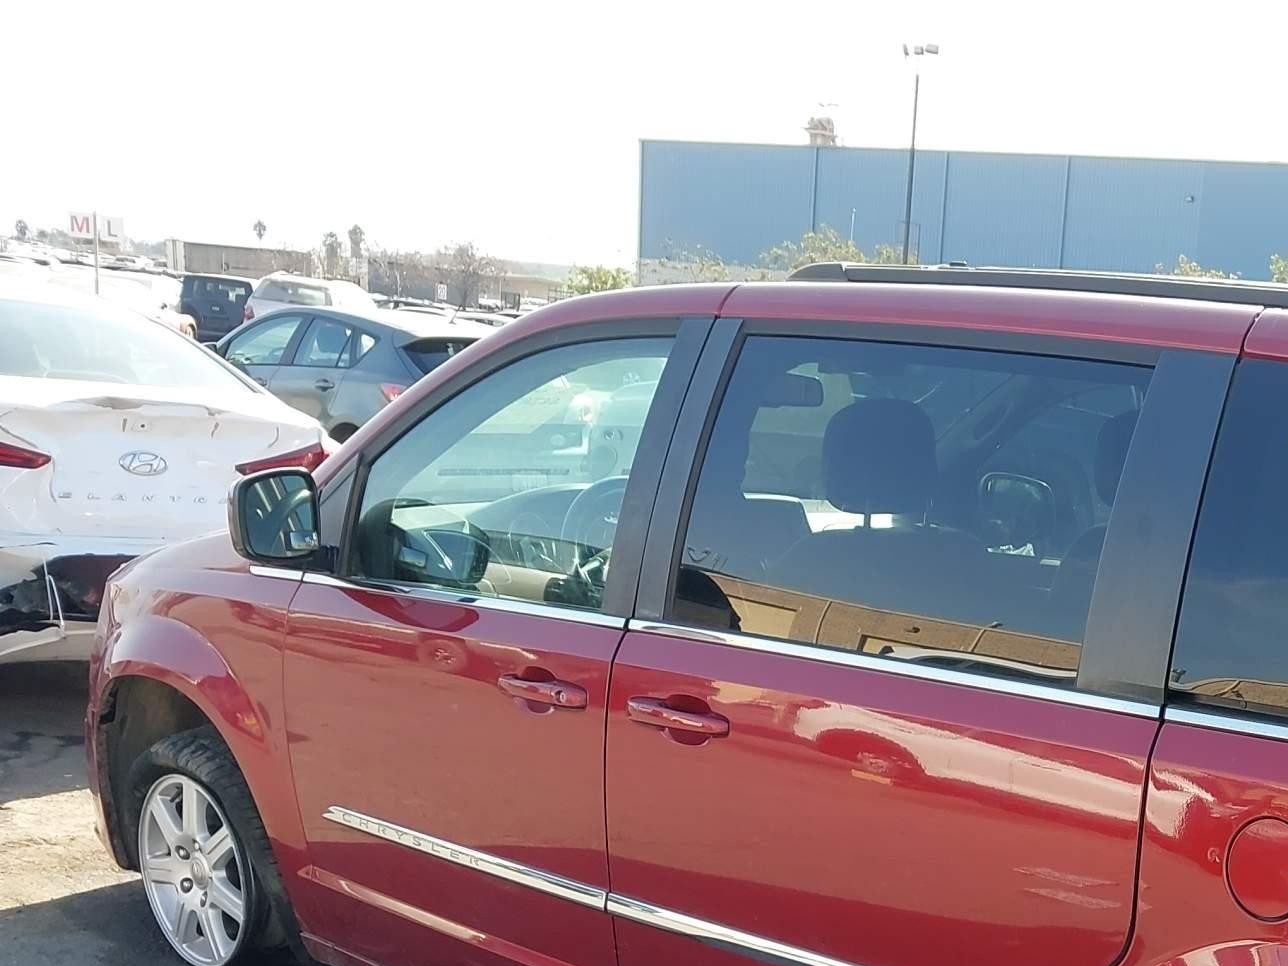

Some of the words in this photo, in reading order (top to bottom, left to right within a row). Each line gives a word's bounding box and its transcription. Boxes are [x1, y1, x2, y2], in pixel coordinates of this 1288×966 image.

[70, 215, 90, 234] M
[107, 219, 118, 238] L
[342, 812, 480, 867] CHRYSLER
